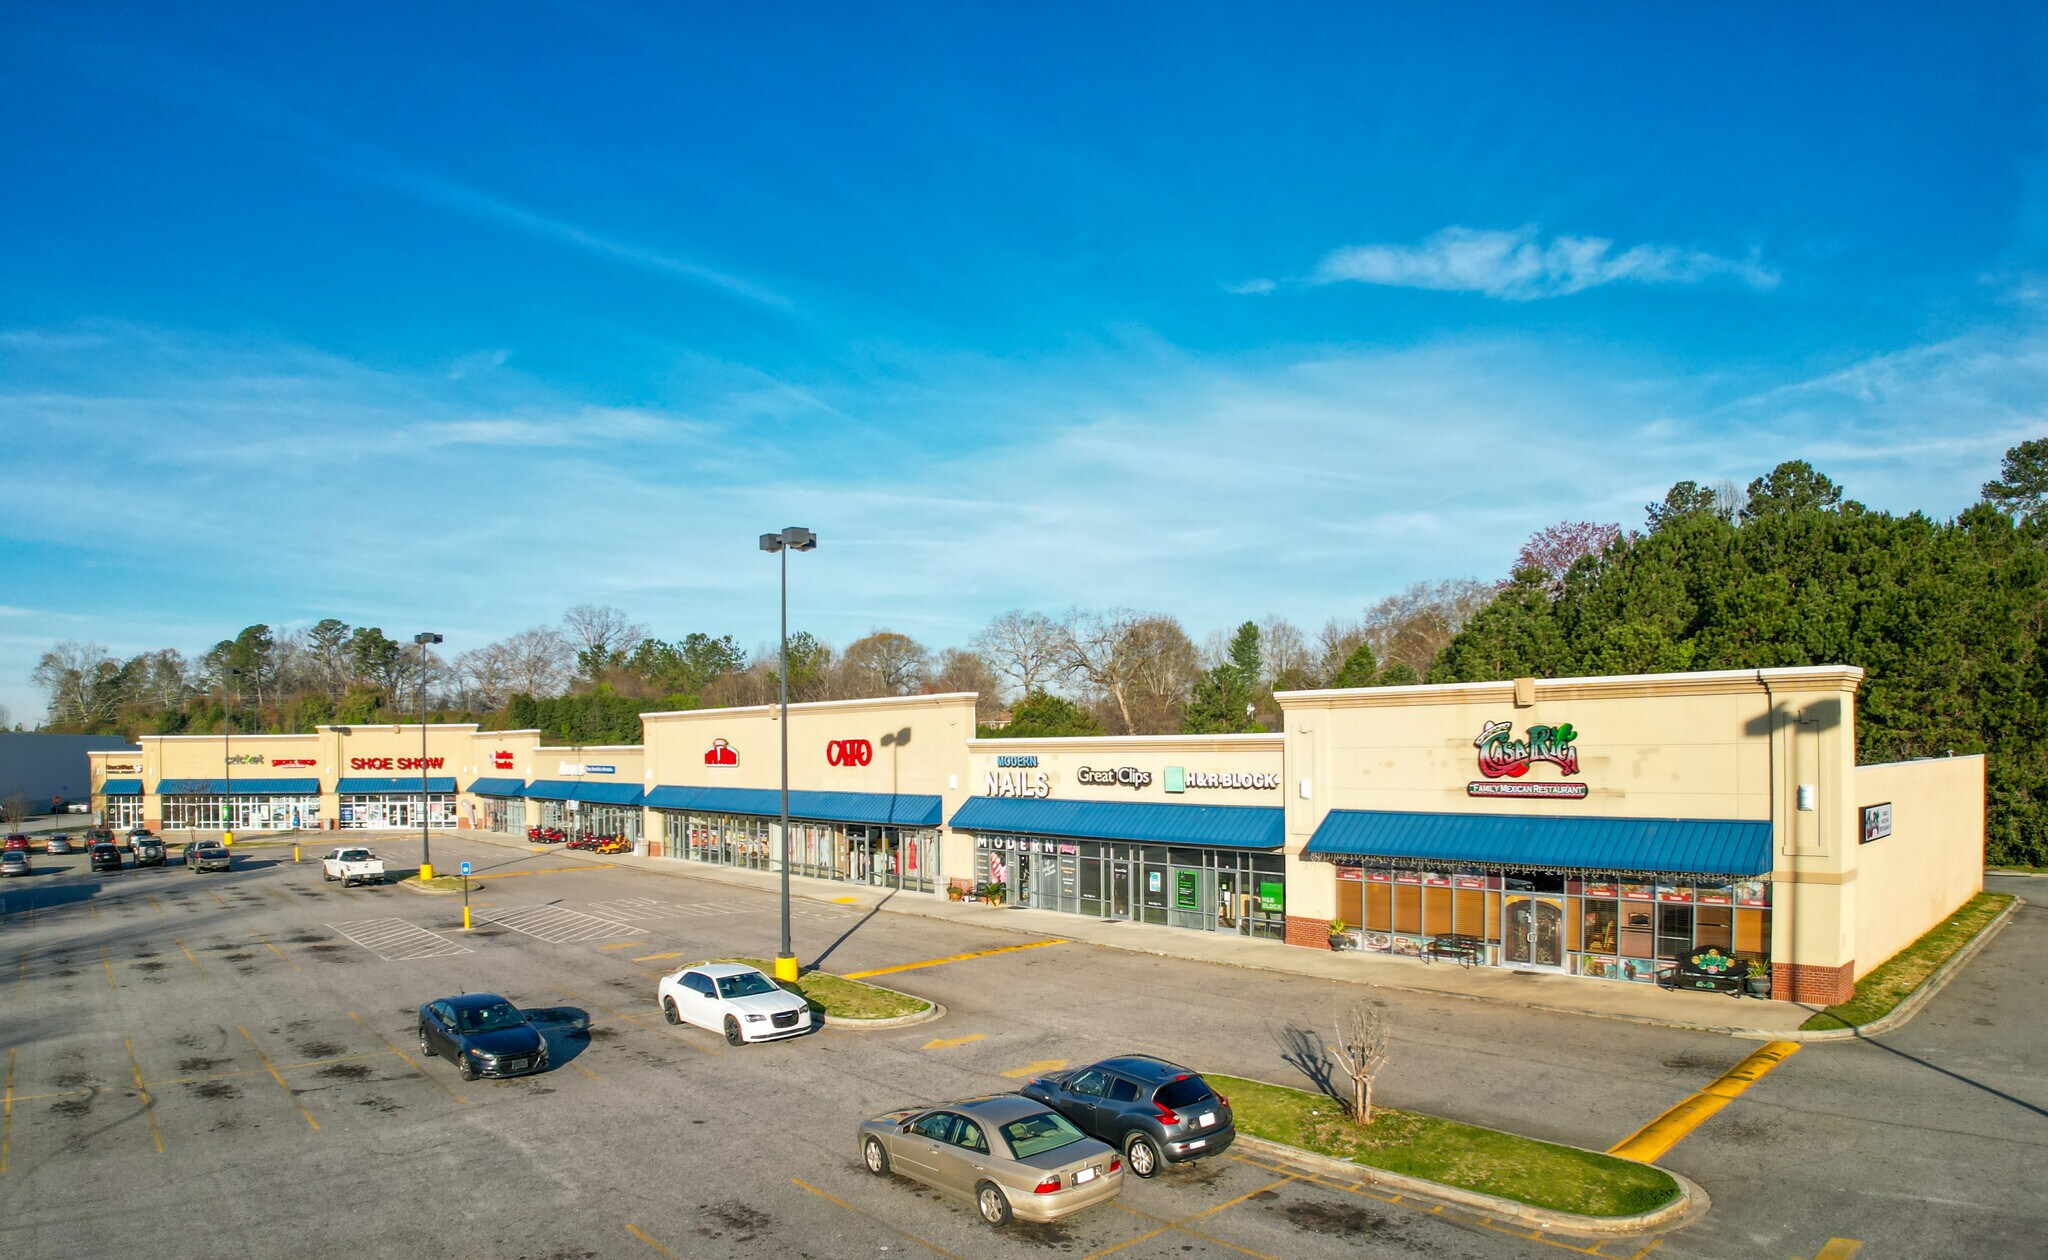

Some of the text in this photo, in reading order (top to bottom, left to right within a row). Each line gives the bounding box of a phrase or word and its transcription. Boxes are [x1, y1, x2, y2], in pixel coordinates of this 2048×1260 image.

[827, 739, 873, 766] CATO
[997, 755, 1038, 767] MODERN
[350, 757, 445, 770] SHOE SHOW
[985, 771, 1050, 798] NAILS
[1077, 767, 1150, 787] Great Clips
[1185, 772, 1276, 788] H&R BLOCK
[1473, 784, 1582, 794] FAMILY MEXICAN RESTAURANT
[977, 835, 1054, 853] MODERN
